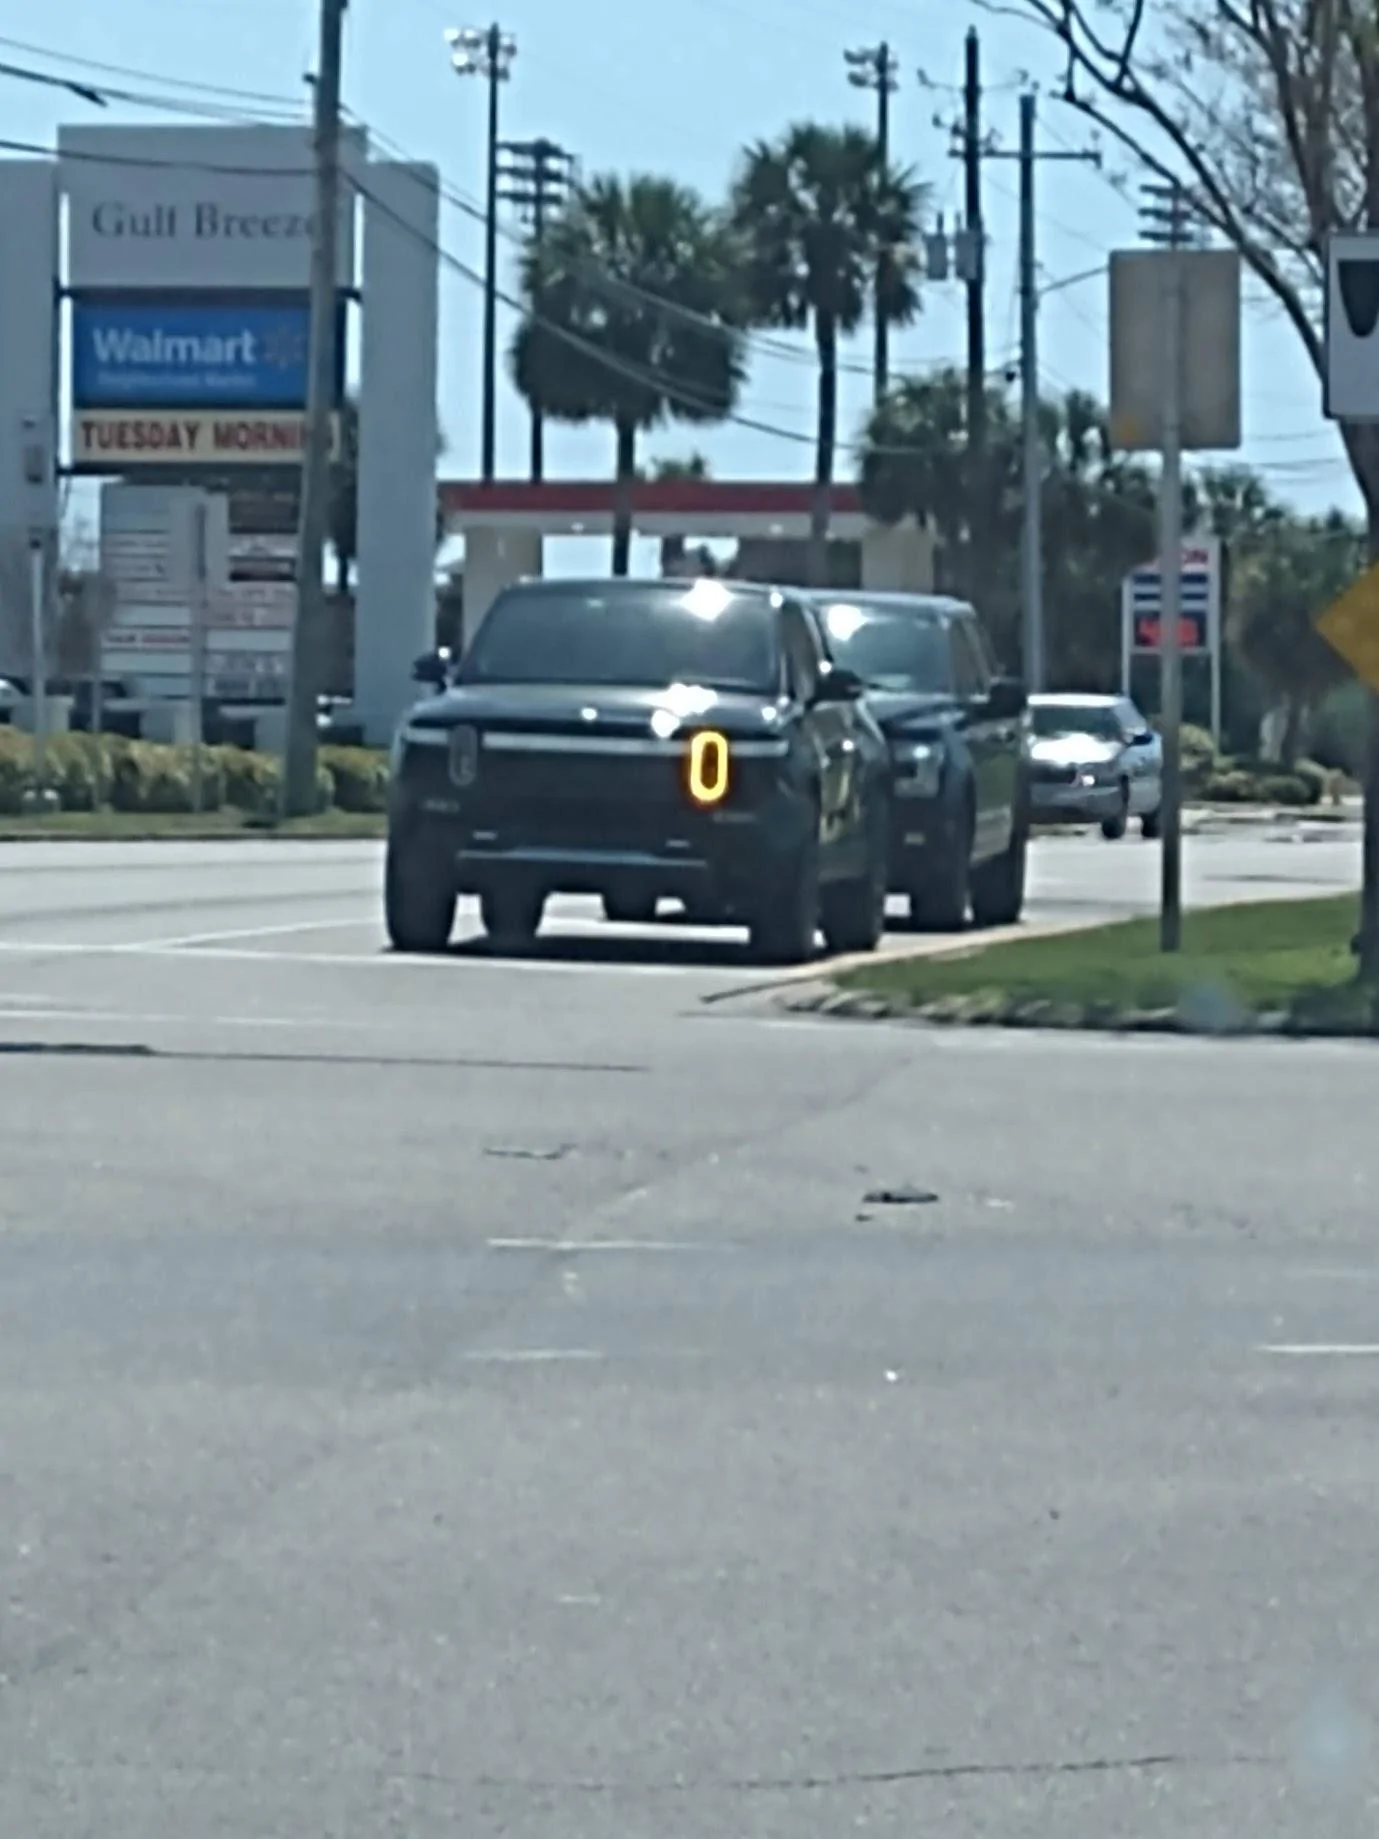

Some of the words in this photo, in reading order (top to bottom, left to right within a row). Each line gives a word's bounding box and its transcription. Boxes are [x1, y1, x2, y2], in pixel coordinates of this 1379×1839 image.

[92, 202, 177, 237] Gulf
[93, 328, 256, 364] Walmart
[81, 421, 199, 451] TUESDAY
[214, 421, 307, 450] MORNI
